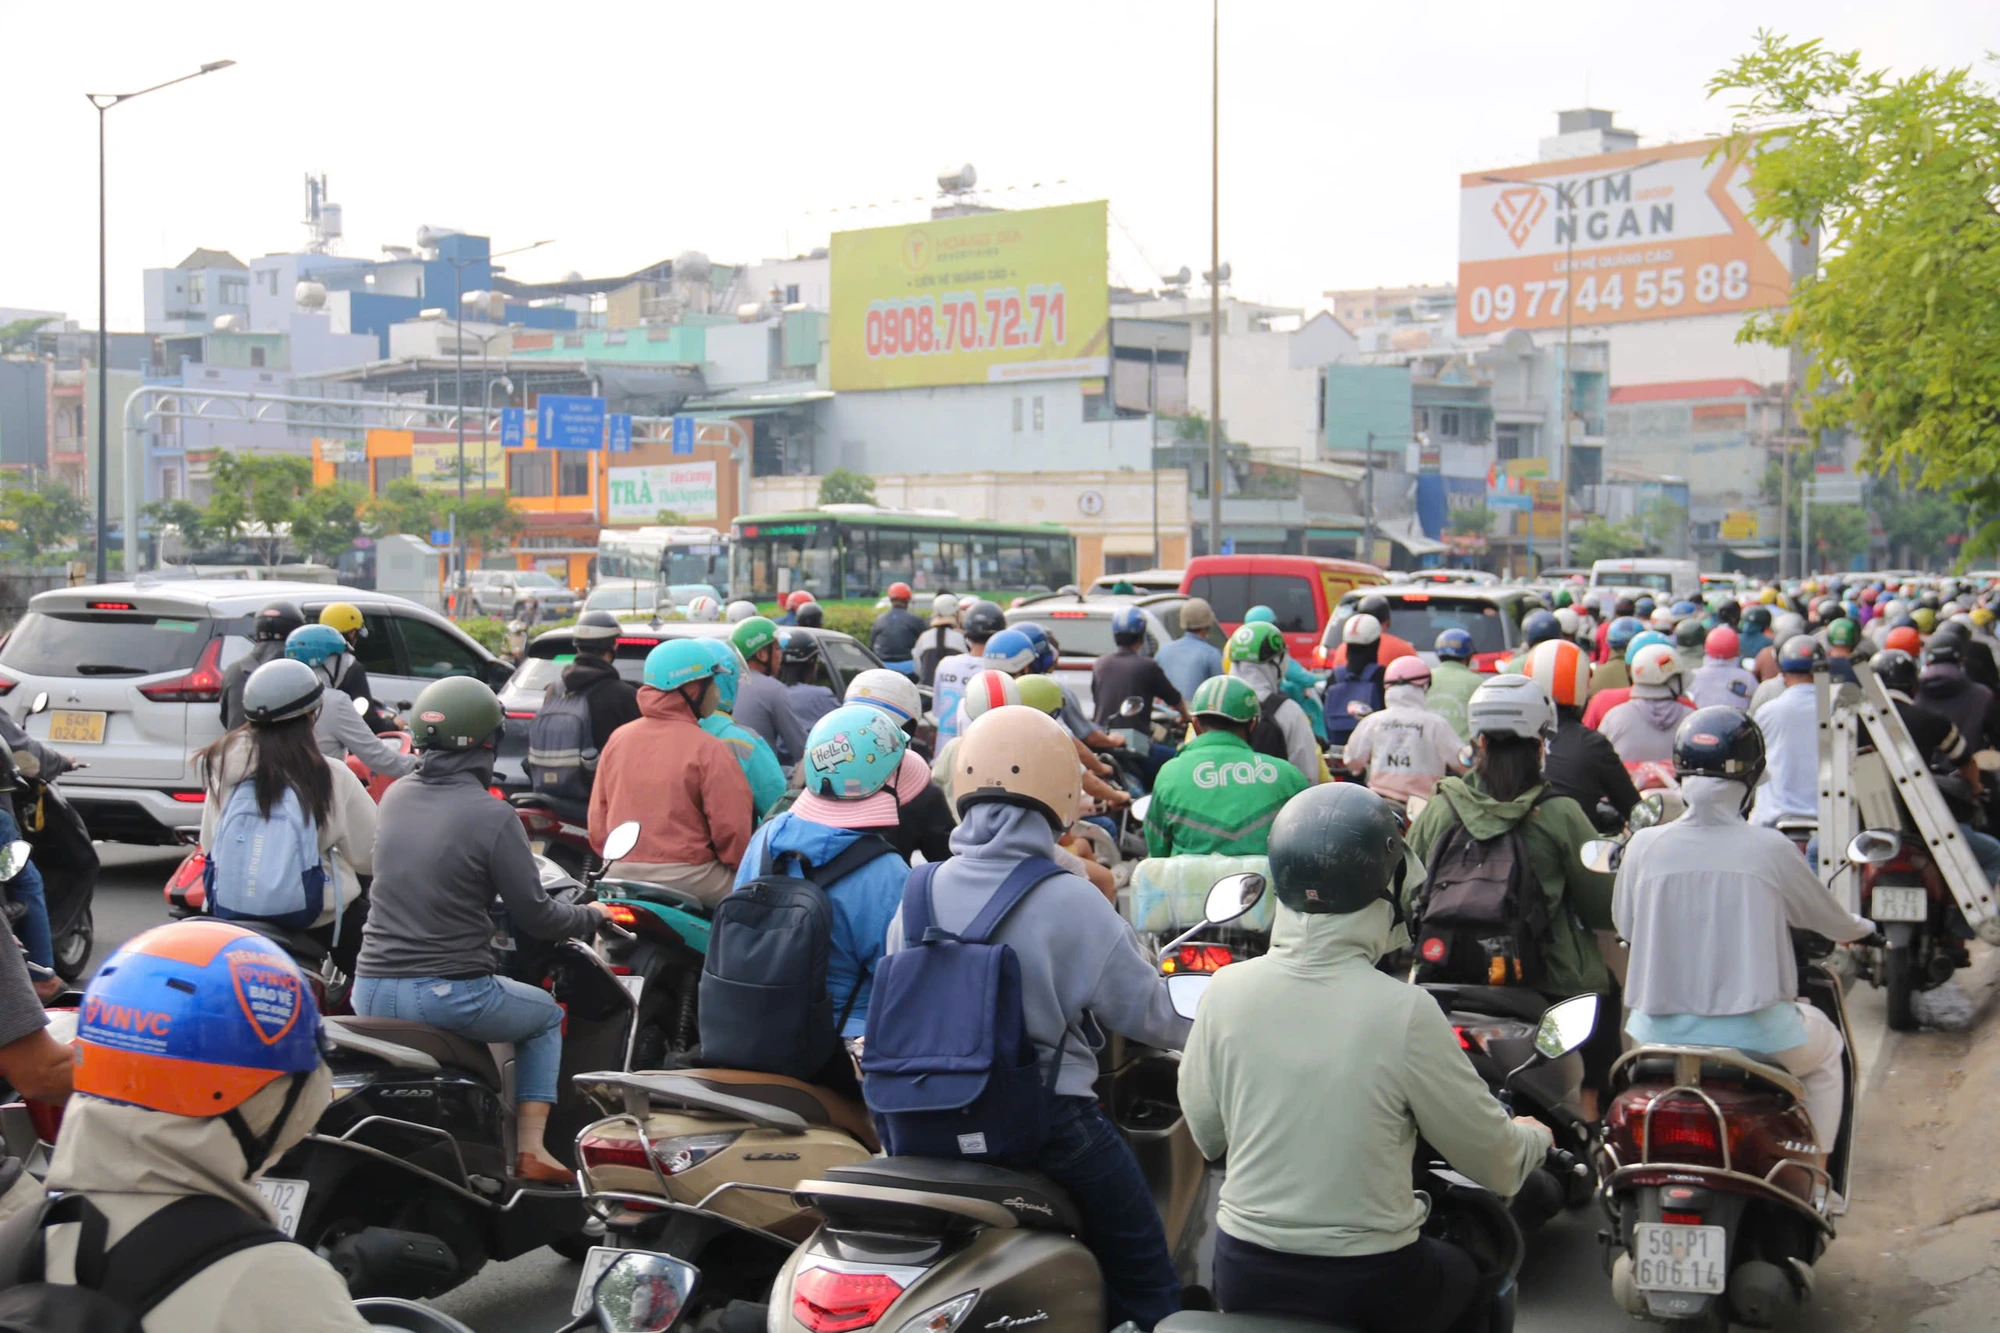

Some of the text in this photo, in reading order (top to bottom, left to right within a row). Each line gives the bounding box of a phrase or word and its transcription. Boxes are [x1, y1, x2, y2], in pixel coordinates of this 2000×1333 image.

[1556, 174, 1631, 211] KIM
[1555, 203, 1674, 245] NGAN
[1469, 260, 1748, 324] 09 77 44 55 88
[866, 290, 1066, 357] 0908.70.72.71
[610, 469, 653, 504] TRÀ
[746, 633, 767, 648] Grab
[1193, 755, 1278, 789] Grab
[254, 969, 299, 992] VNVC
[101, 1002, 172, 1036] VNVC
[380, 1089, 433, 1098] LEAD
[1649, 1229, 1708, 1258] 59-P1
[1641, 1258, 1719, 1288] 606.14
